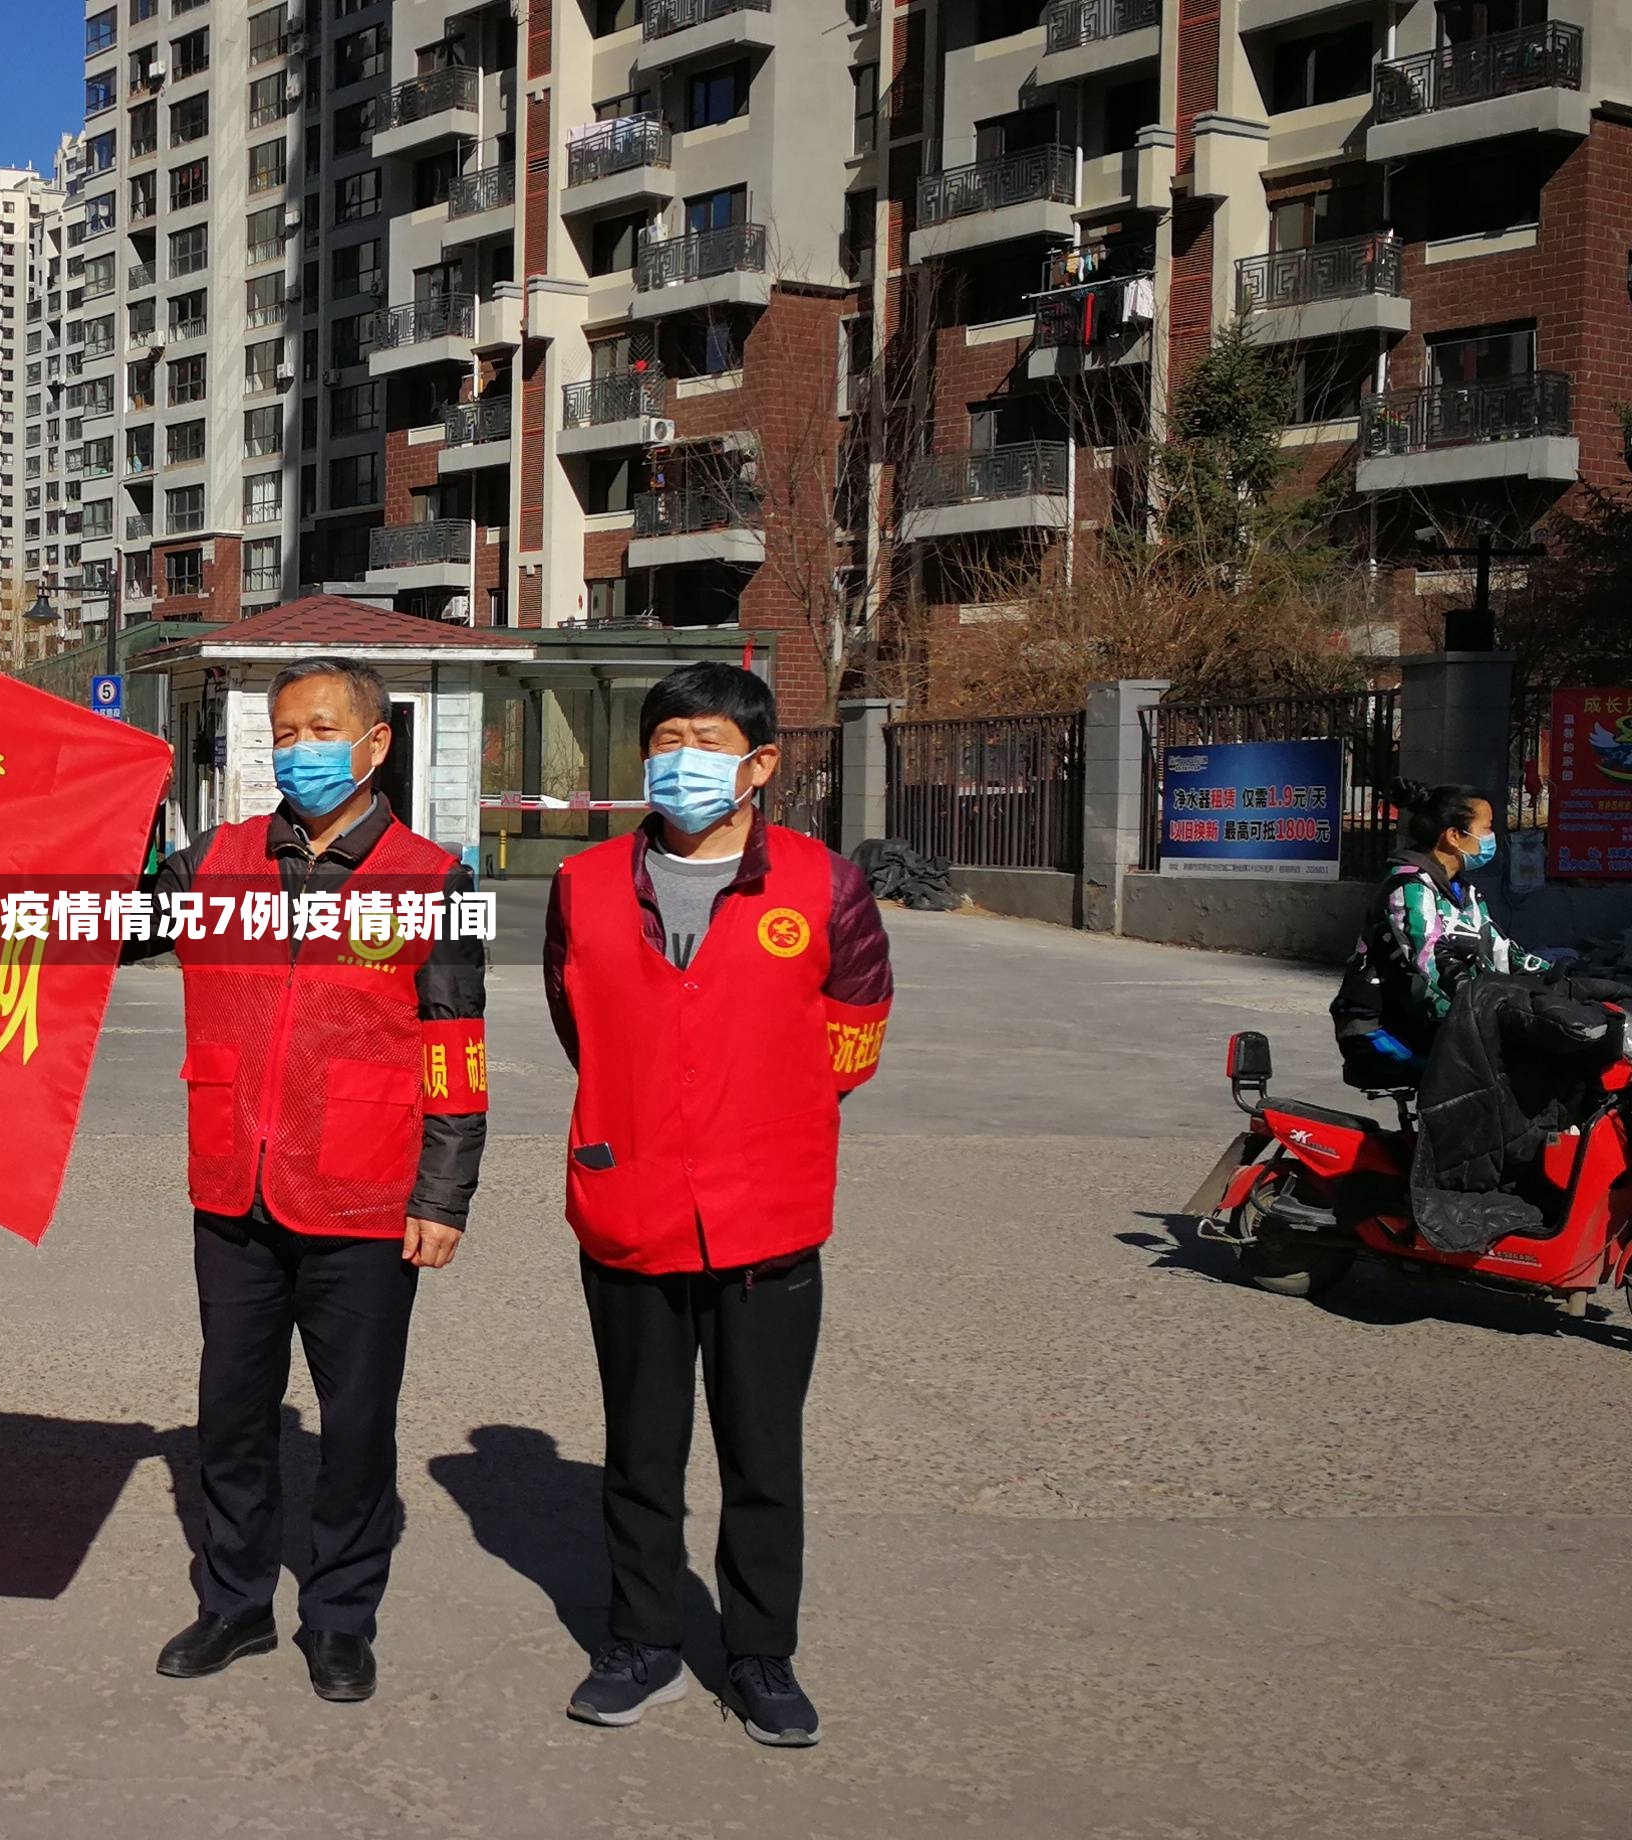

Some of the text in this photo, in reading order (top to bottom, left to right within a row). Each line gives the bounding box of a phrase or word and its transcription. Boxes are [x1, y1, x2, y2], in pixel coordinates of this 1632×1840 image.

[102, 684, 111, 699] 5
[1173, 784, 1327, 811] 净水器租赁 仅需1.9元/天
[1169, 817, 1331, 843] 以旧换新 最高可抵1800元
[423, 1042, 449, 1099] 员
